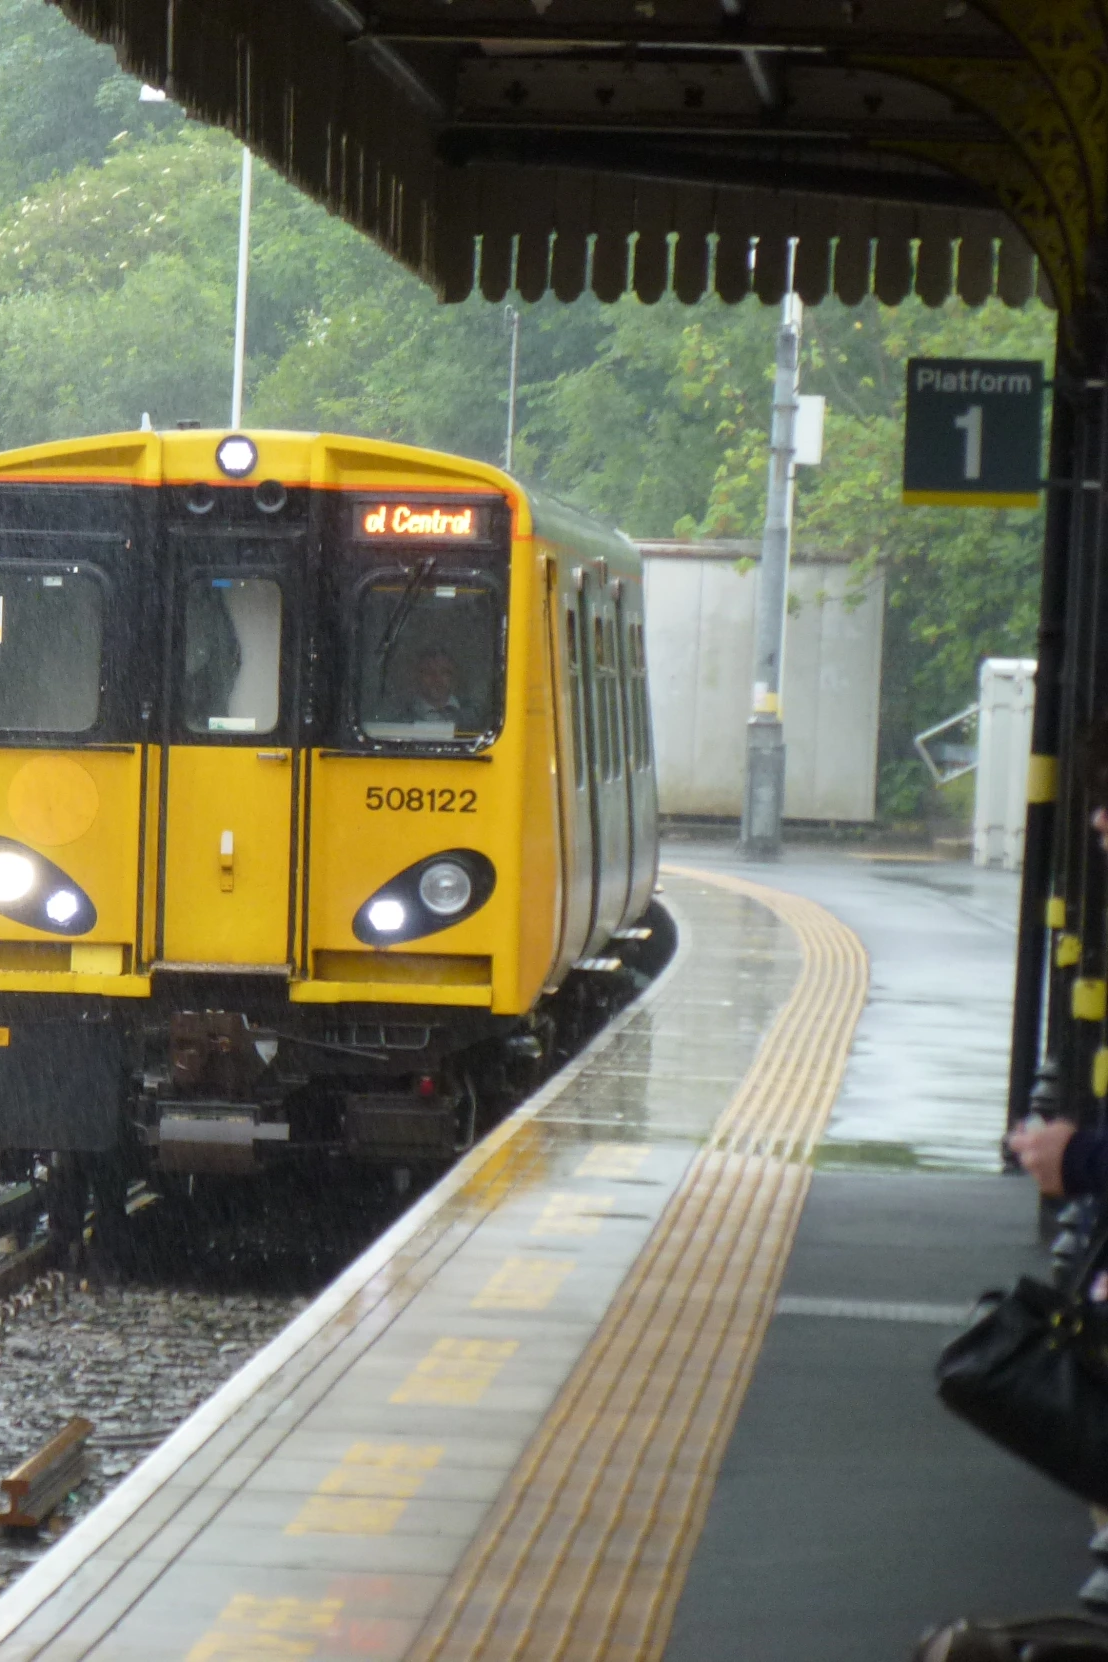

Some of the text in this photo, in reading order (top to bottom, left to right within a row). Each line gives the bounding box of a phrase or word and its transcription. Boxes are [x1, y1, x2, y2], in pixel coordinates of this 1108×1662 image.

[917, 368, 1032, 394] Platform
[954, 404, 983, 480] 1
[365, 786, 478, 813] 508122
